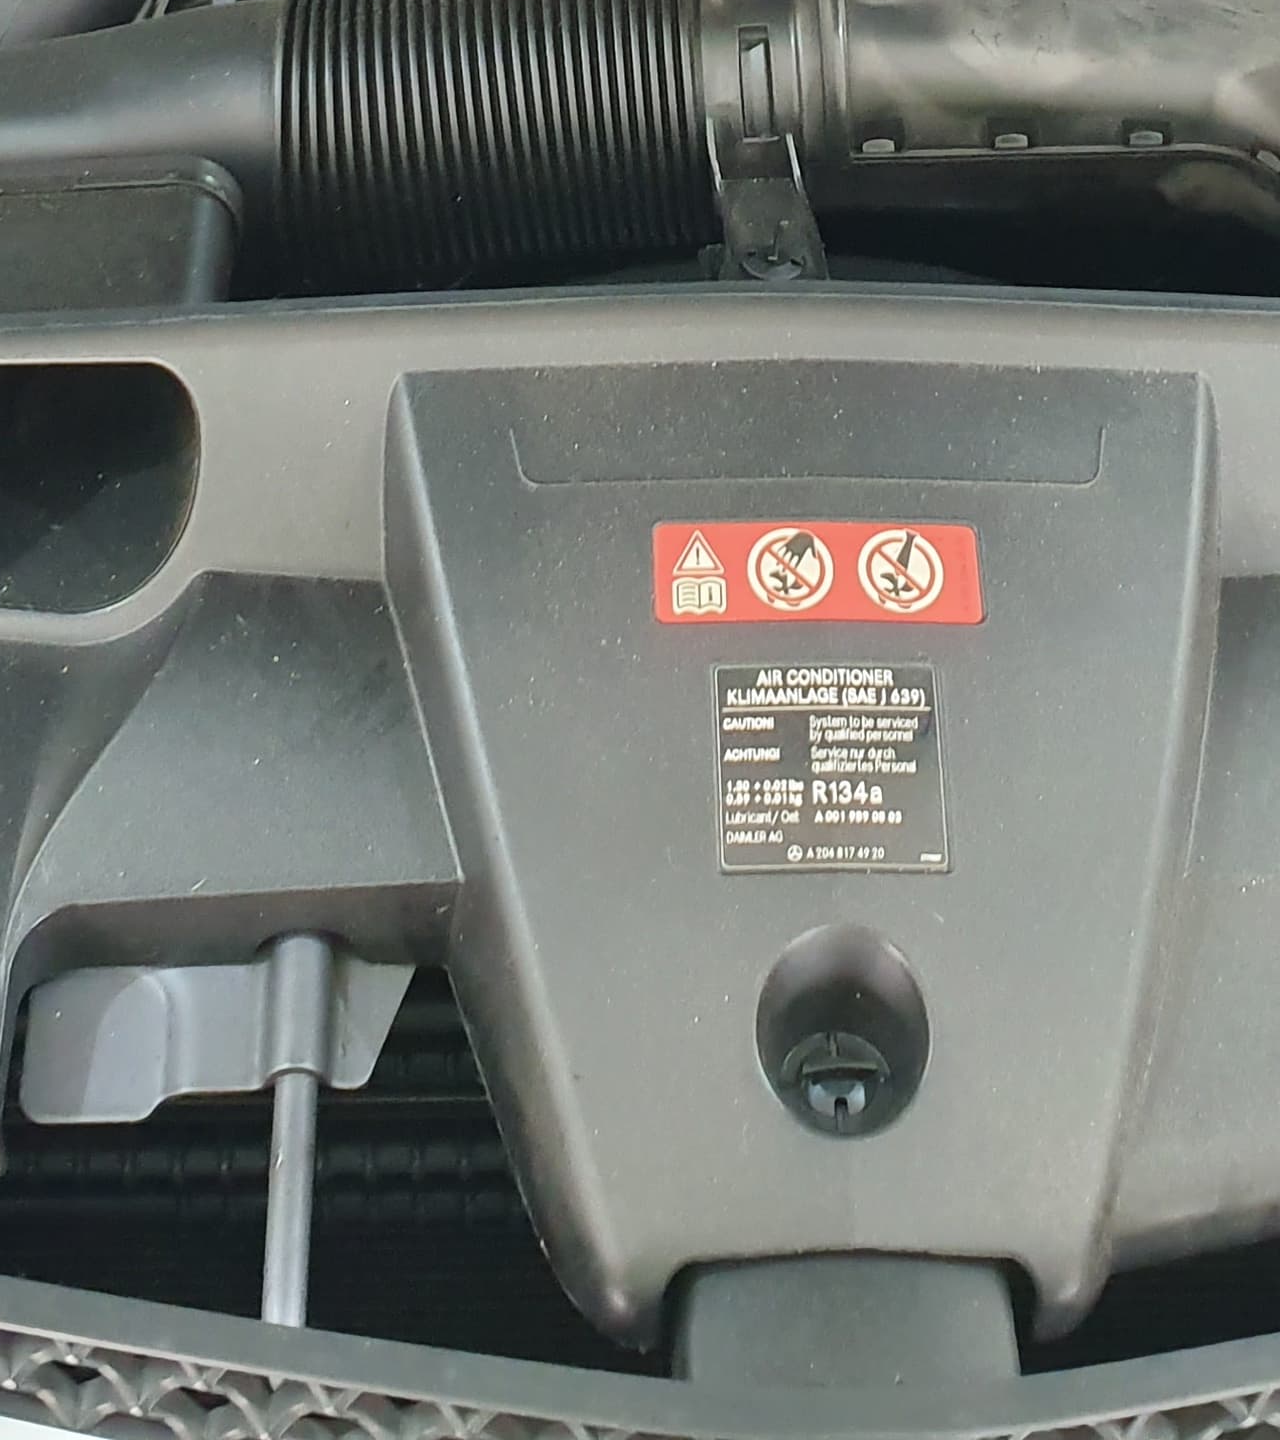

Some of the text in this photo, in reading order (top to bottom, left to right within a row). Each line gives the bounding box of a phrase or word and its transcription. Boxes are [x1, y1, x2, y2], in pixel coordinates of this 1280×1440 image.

[756, 667, 894, 686] AIR CONDITIONER
[727, 687, 926, 707] KLIMAANLAGE (SAE J 639)
[809, 715, 919, 730] System to be serviced
[809, 728, 914, 743] by qualified personnel
[811, 745, 896, 760] Service nur durch
[812, 759, 917, 774] qualifiziertes Personal
[812, 779, 883, 805] R134a
[814, 810, 824, 823] A
[726, 830, 784, 844] DAIMLER AG
[806, 847, 814, 859] A
[816, 846, 835, 860] 204
[872, 846, 885, 860] 20
